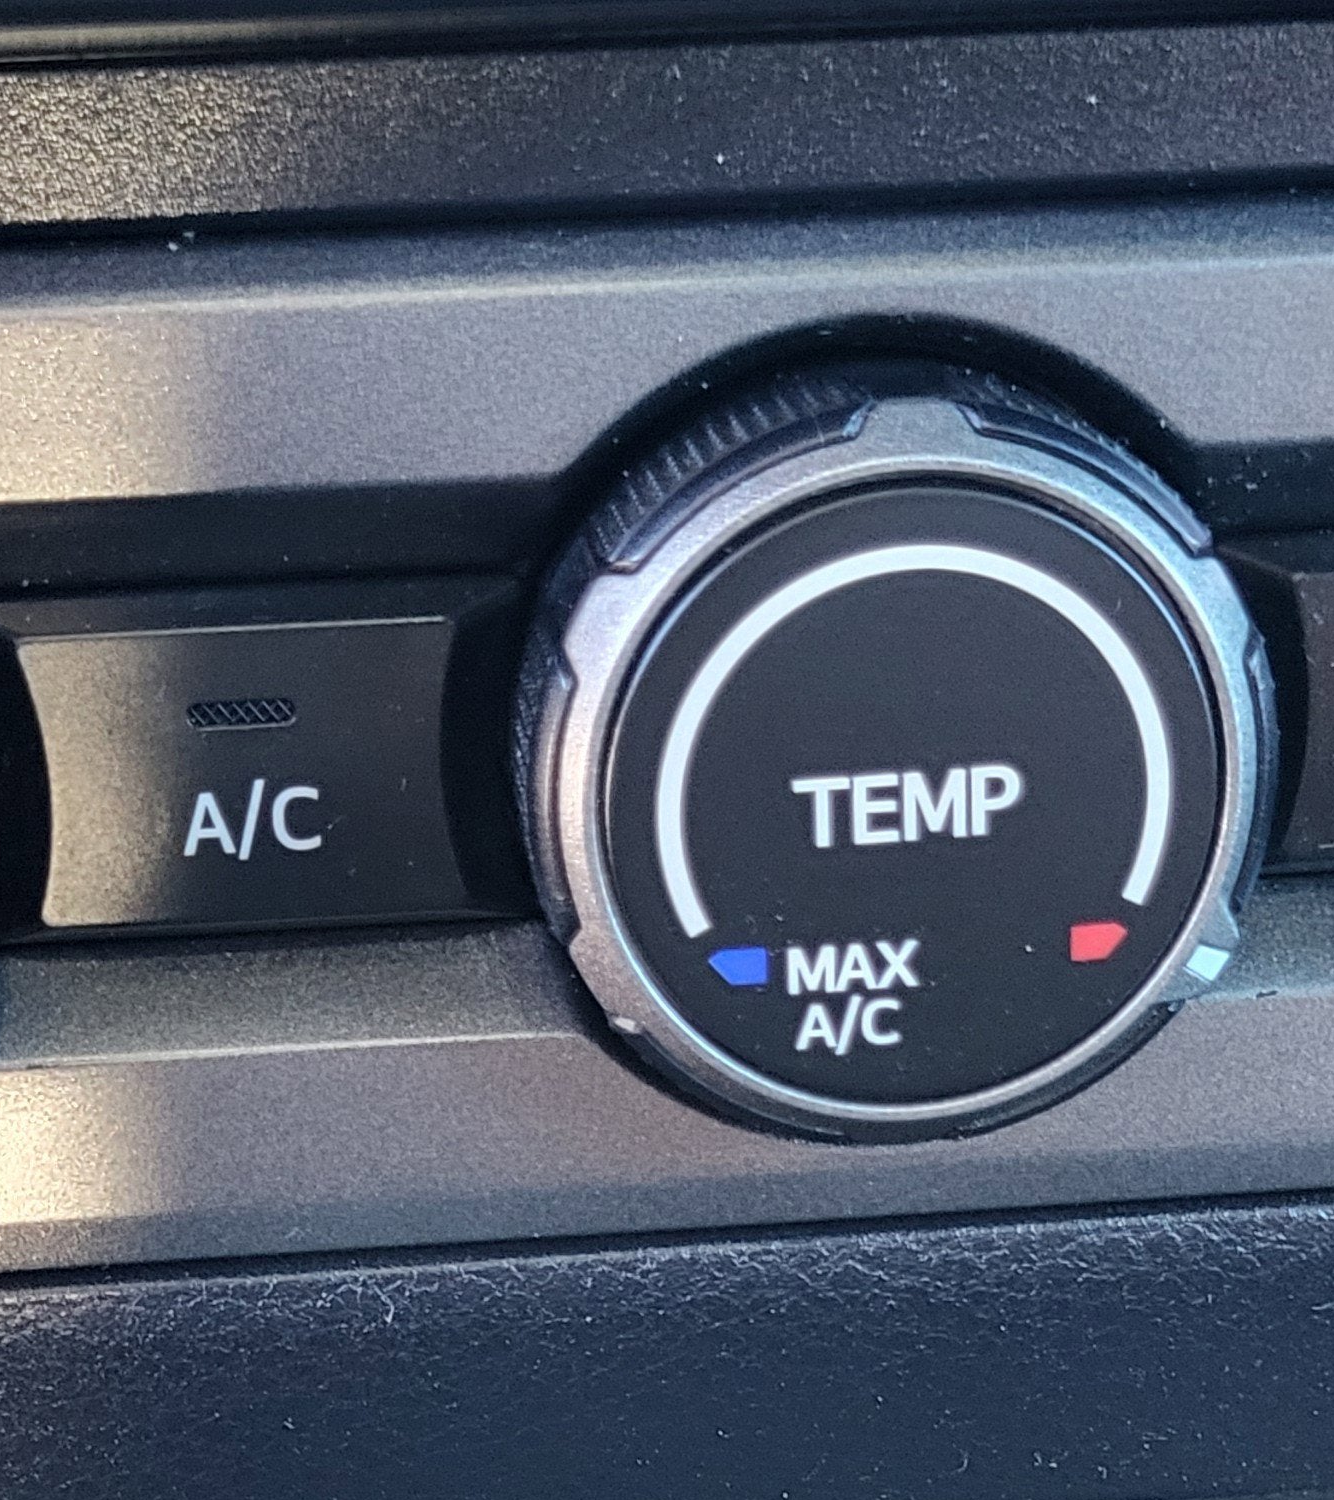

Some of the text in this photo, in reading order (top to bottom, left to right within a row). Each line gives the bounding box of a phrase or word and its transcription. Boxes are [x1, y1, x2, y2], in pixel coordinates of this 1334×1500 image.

[183, 779, 322, 861] A/C
[791, 764, 1022, 849] TEMP
[785, 937, 920, 994] MAX
[796, 994, 901, 1057] A/C
